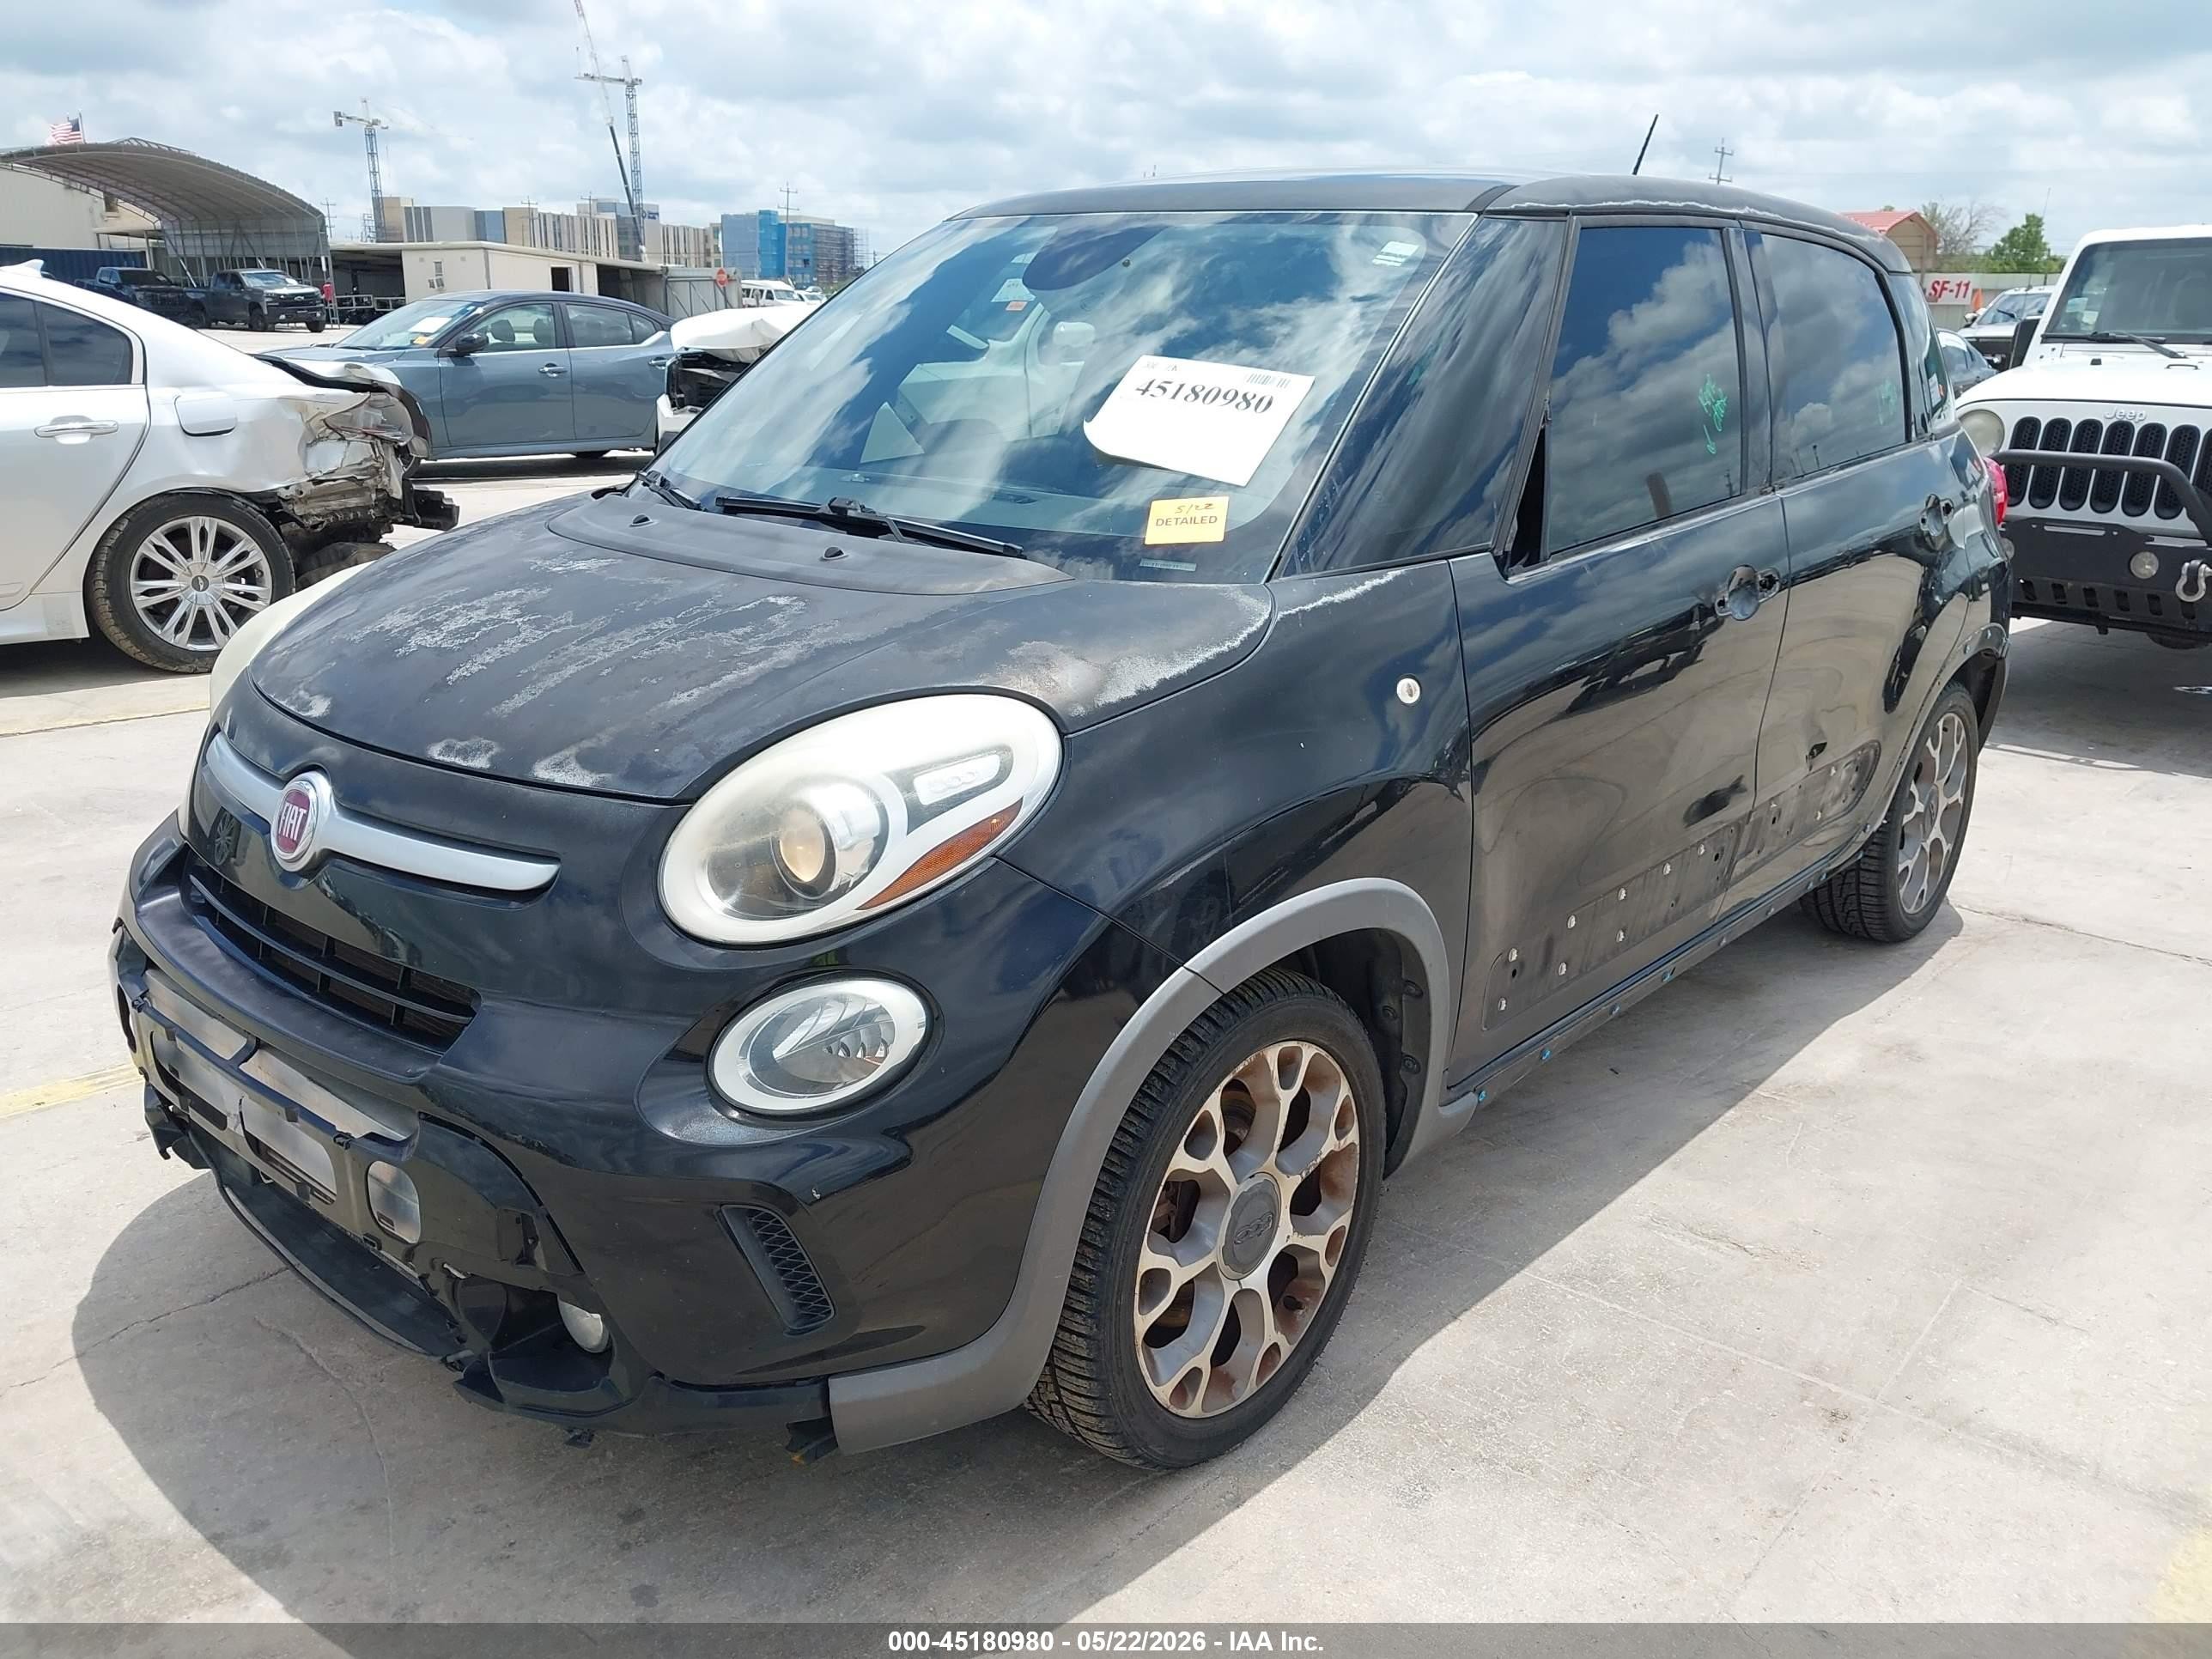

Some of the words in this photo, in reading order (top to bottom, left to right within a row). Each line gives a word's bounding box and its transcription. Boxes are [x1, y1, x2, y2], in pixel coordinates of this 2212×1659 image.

[1928, 279, 1971, 299] SF-11
[1134, 378, 1275, 414] 45180980
[2104, 405, 2148, 423] Jeep
[1155, 515, 1218, 526] DETAILED
[278, 801, 308, 842] FIAT
